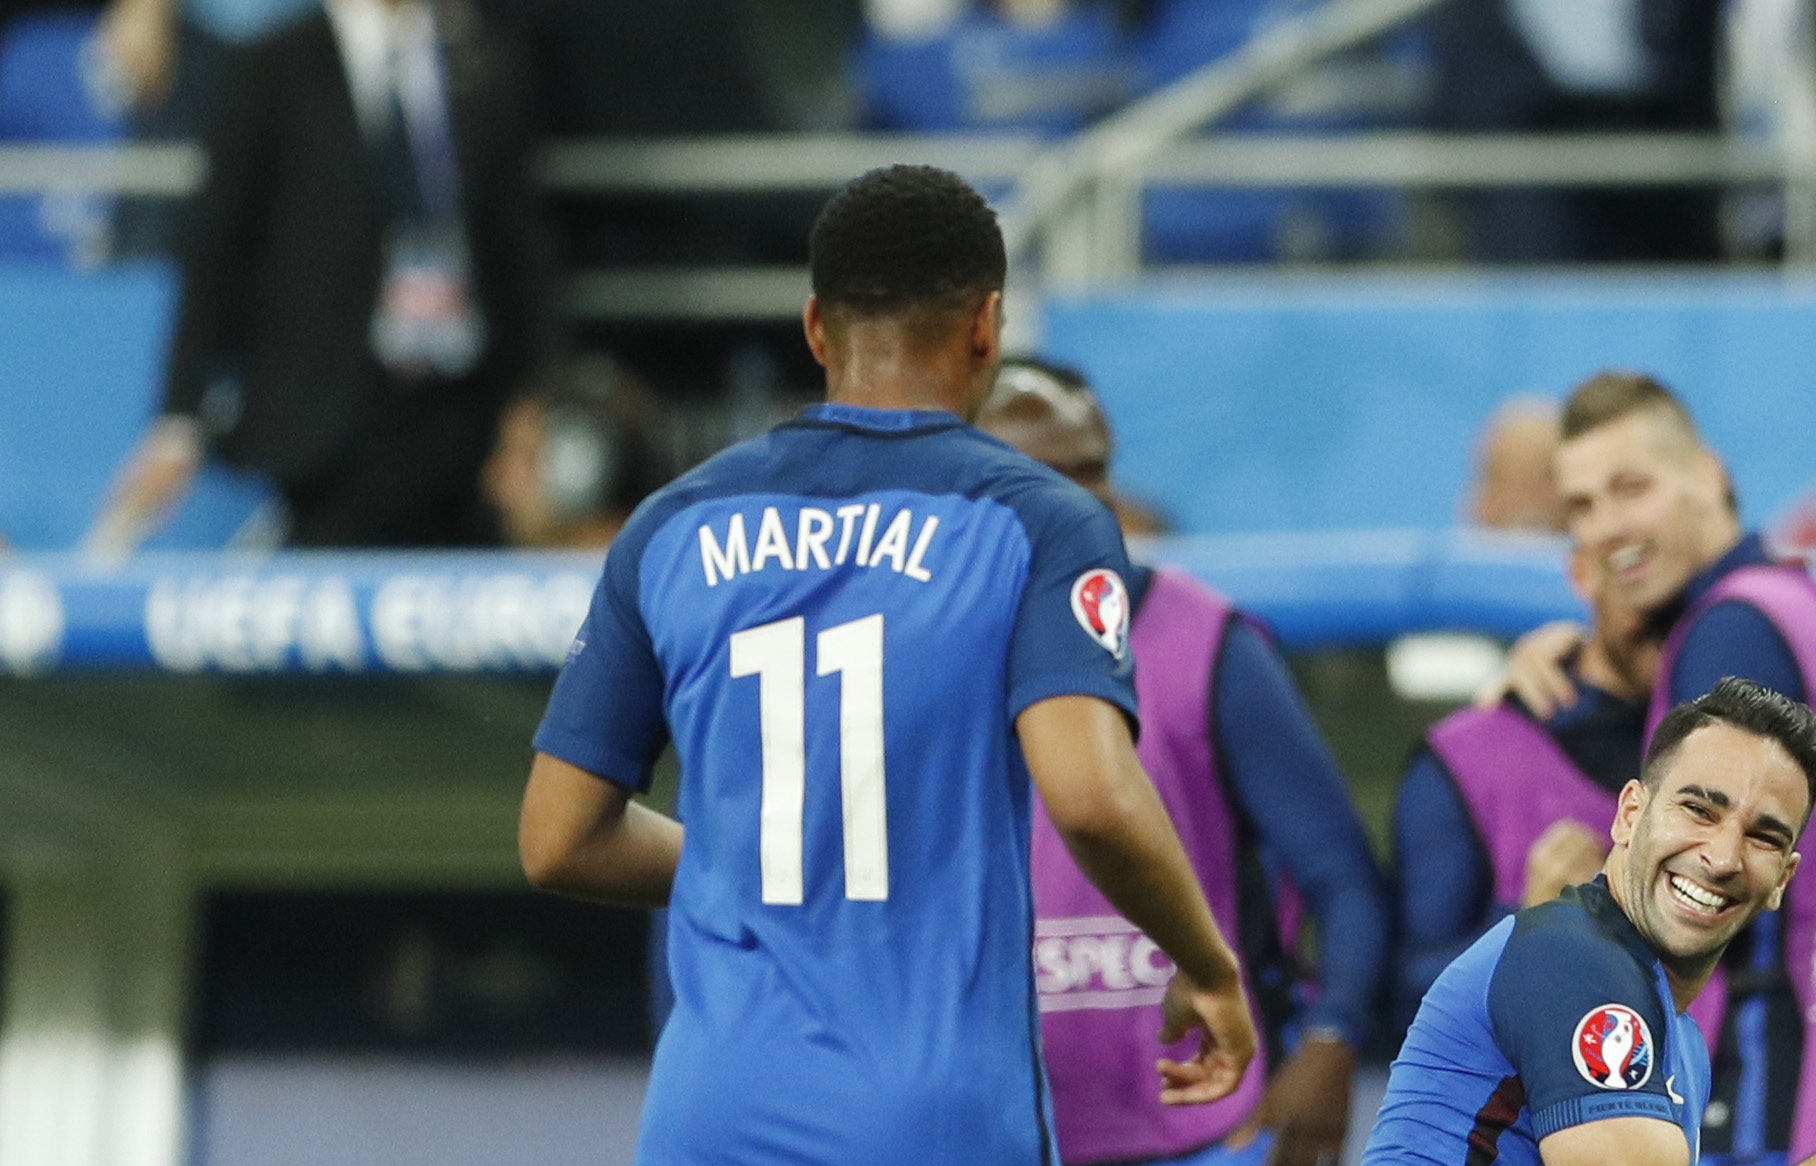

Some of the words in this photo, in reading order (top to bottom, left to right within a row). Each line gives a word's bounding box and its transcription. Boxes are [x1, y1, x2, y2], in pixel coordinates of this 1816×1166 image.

[698, 502, 940, 588] MARTIAL
[146, 576, 362, 671] UEFA
[729, 612, 889, 906] 11
